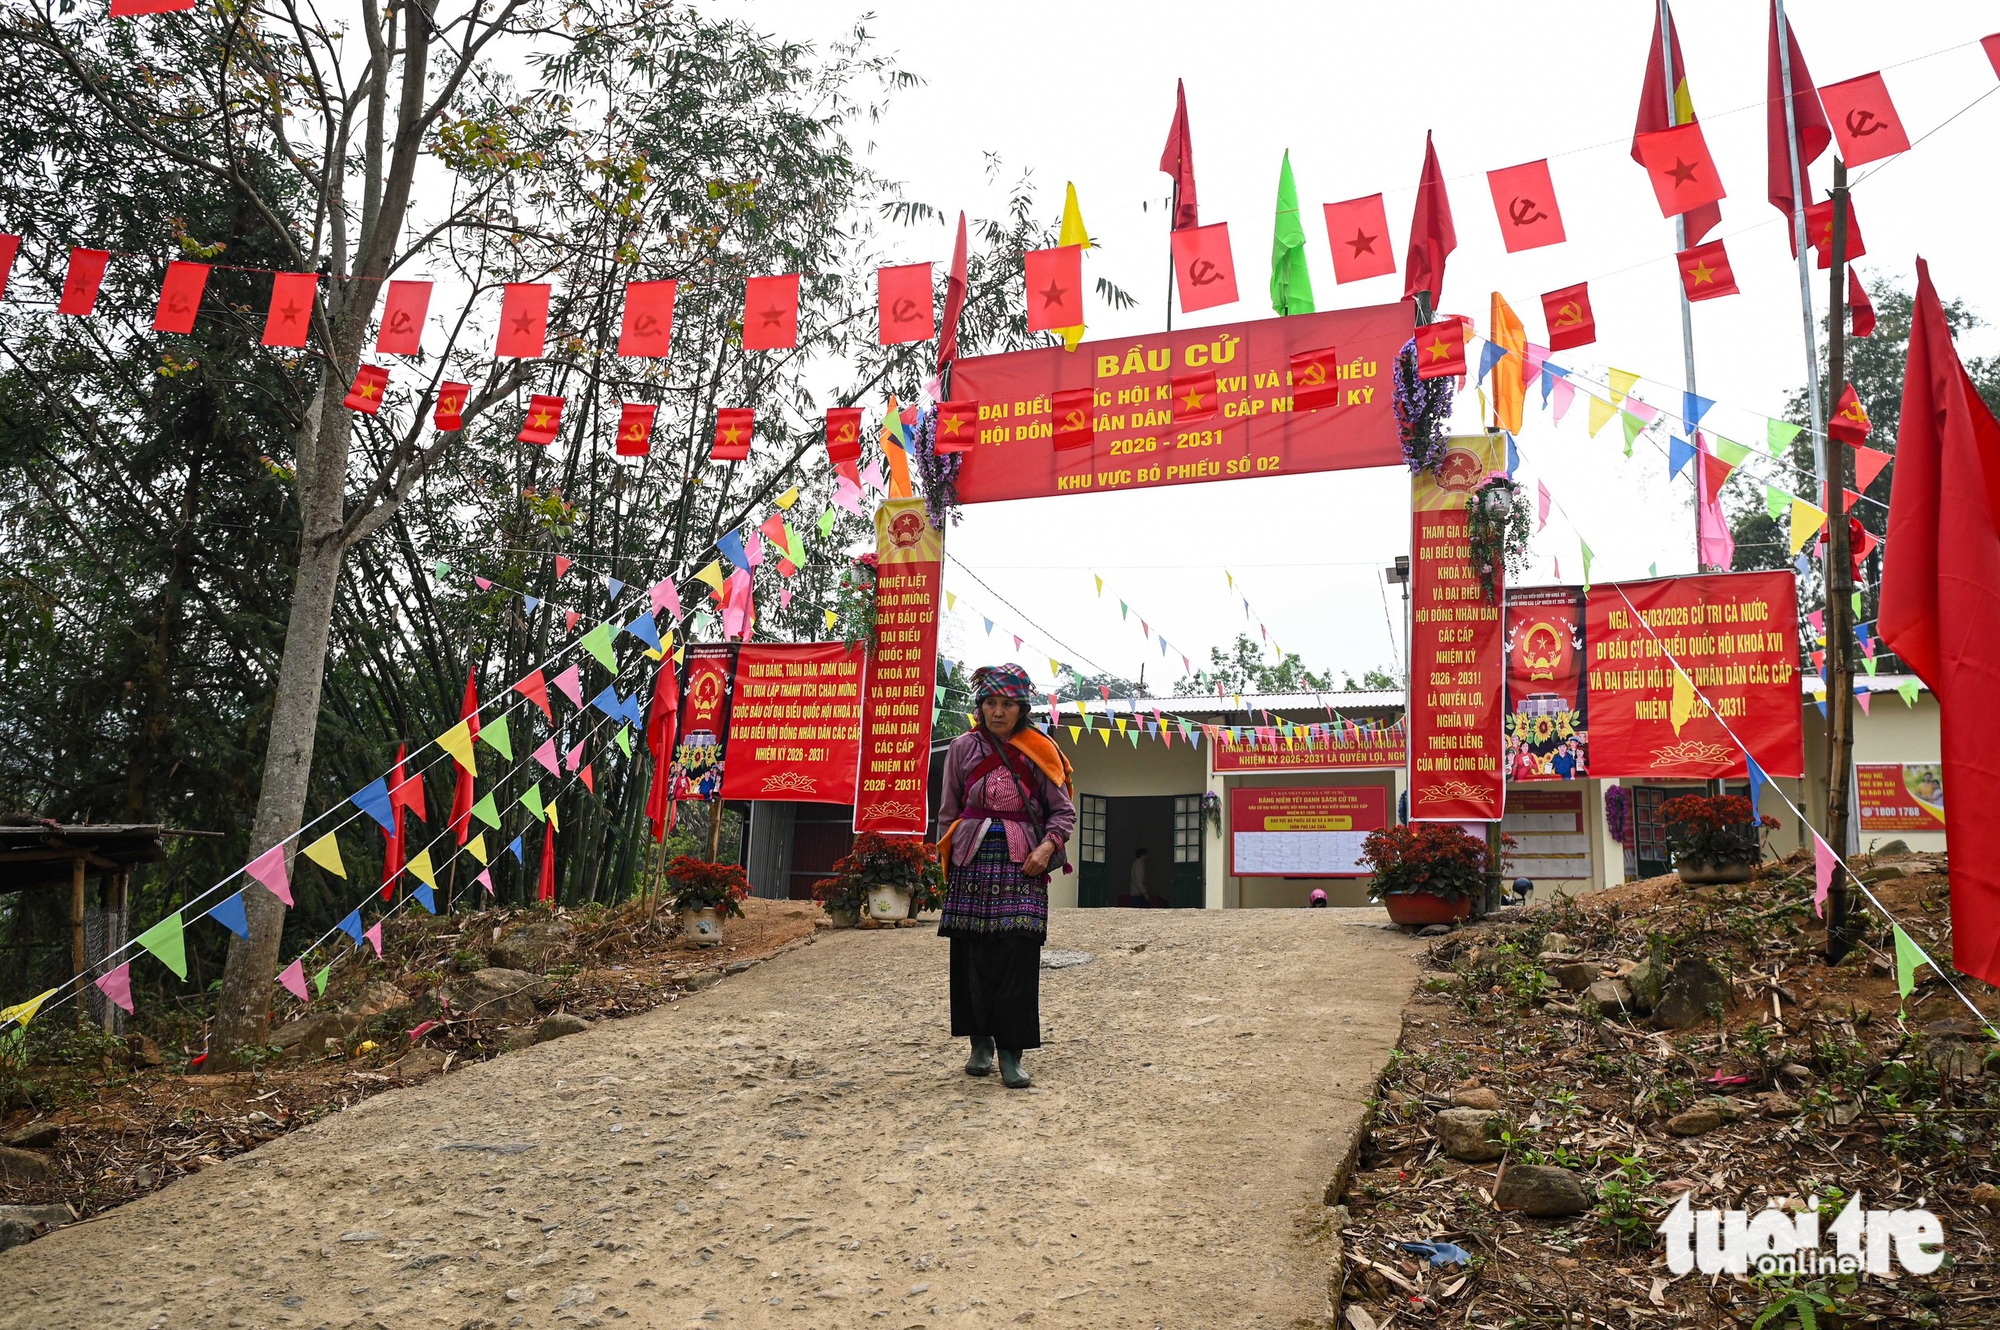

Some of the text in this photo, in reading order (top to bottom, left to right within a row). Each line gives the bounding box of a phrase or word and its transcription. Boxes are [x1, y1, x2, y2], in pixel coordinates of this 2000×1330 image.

[1097, 334, 1240, 378] BẦU CỬ
[979, 403, 1008, 422] ĐẠI
[1119, 385, 1150, 408] HỘI
[1216, 376, 1247, 394] XVI
[1254, 370, 1280, 390] VÀ
[981, 426, 1010, 446] HỘI
[1016, 420, 1052, 440] ĐỒN
[1132, 409, 1171, 428] DÂN
[1224, 396, 1264, 418] CẤP
[1348, 386, 1374, 406] KỲ
[1110, 430, 1222, 456] 2026 2031
[1058, 454, 1280, 490] KHU VỰC BỎ PHIẾU SỐ 02
[1422, 526, 1444, 539] THAM
[1447, 526, 1460, 538] GIA
[1420, 547, 1433, 562] ĐẠI
[1436, 541, 1454, 559] BIỂU
[1438, 564, 1459, 580] KHOÁ
[879, 573, 926, 590] NHIỆT LIỆT
[876, 590, 930, 606] CHÀO MỪNG
[1433, 582, 1480, 602] VÀ ĐẠI BIỂU
[898, 607, 934, 624] BẦU CỬ
[1416, 604, 1498, 625] HỘI ĐỒNG NHÂN DÂN
[1691, 598, 1705, 624] CỬ
[1706, 604, 1722, 624] TRI
[1725, 596, 1738, 622] CẢ
[1741, 596, 1768, 622] NƯỚC
[880, 626, 920, 645] ĐẠI BIỂU
[1438, 624, 1474, 642] CÁC CẤP
[878, 646, 921, 662] QUỐC HỘI
[1597, 642, 1606, 660] ĐI
[1609, 636, 1628, 660] BẦU
[1646, 638, 1662, 661] ĐẠI
[1664, 630, 1686, 657] BIỂU
[1689, 630, 1715, 658] QUỐC
[1718, 632, 1734, 658] HỘI
[1738, 630, 1764, 654] KHOÁ
[1766, 632, 1784, 652] XVI
[1436, 648, 1476, 666] NHIỆM KỲ
[878, 666, 920, 679] KHOÁ XVI
[1430, 672, 1481, 685] 2026 2031!
[1590, 668, 1602, 690] VÀ
[1605, 671, 1620, 694] ĐẠI
[1624, 663, 1644, 690] BIỂU
[1648, 665, 1664, 692] HỘI
[1696, 664, 1722, 686] NHÂN
[1726, 662, 1746, 685] DÂN
[1750, 660, 1769, 684] CÁC
[1772, 658, 1792, 684] CẤP
[872, 681, 925, 700] VÀ ĐẠI BIỂU
[1428, 690, 1437, 706] LÀ
[1440, 688, 1466, 708] QUYỀN
[876, 700, 918, 719] HỘI ĐỒNG
[1636, 696, 1667, 724] NHIỆM
[1718, 696, 1746, 716] 2031!
[872, 720, 920, 735] NHÂN DÂN
[1436, 712, 1474, 730] NGHĨA VỤ
[874, 738, 914, 753] CÁC CẤP
[1428, 733, 1483, 749] THIÊNG LIÊNG
[787, 748, 803, 760] 2026
[808, 748, 824, 760] 2031
[1281, 754, 1324, 764] 2026-2031
[1417, 753, 1496, 771] CỦA MỖI CÔNG DÂN
[871, 758, 916, 774] NHIỆM KỲ
[864, 779, 920, 791] 2026 2031!
[1875, 807, 1896, 816] 1800
